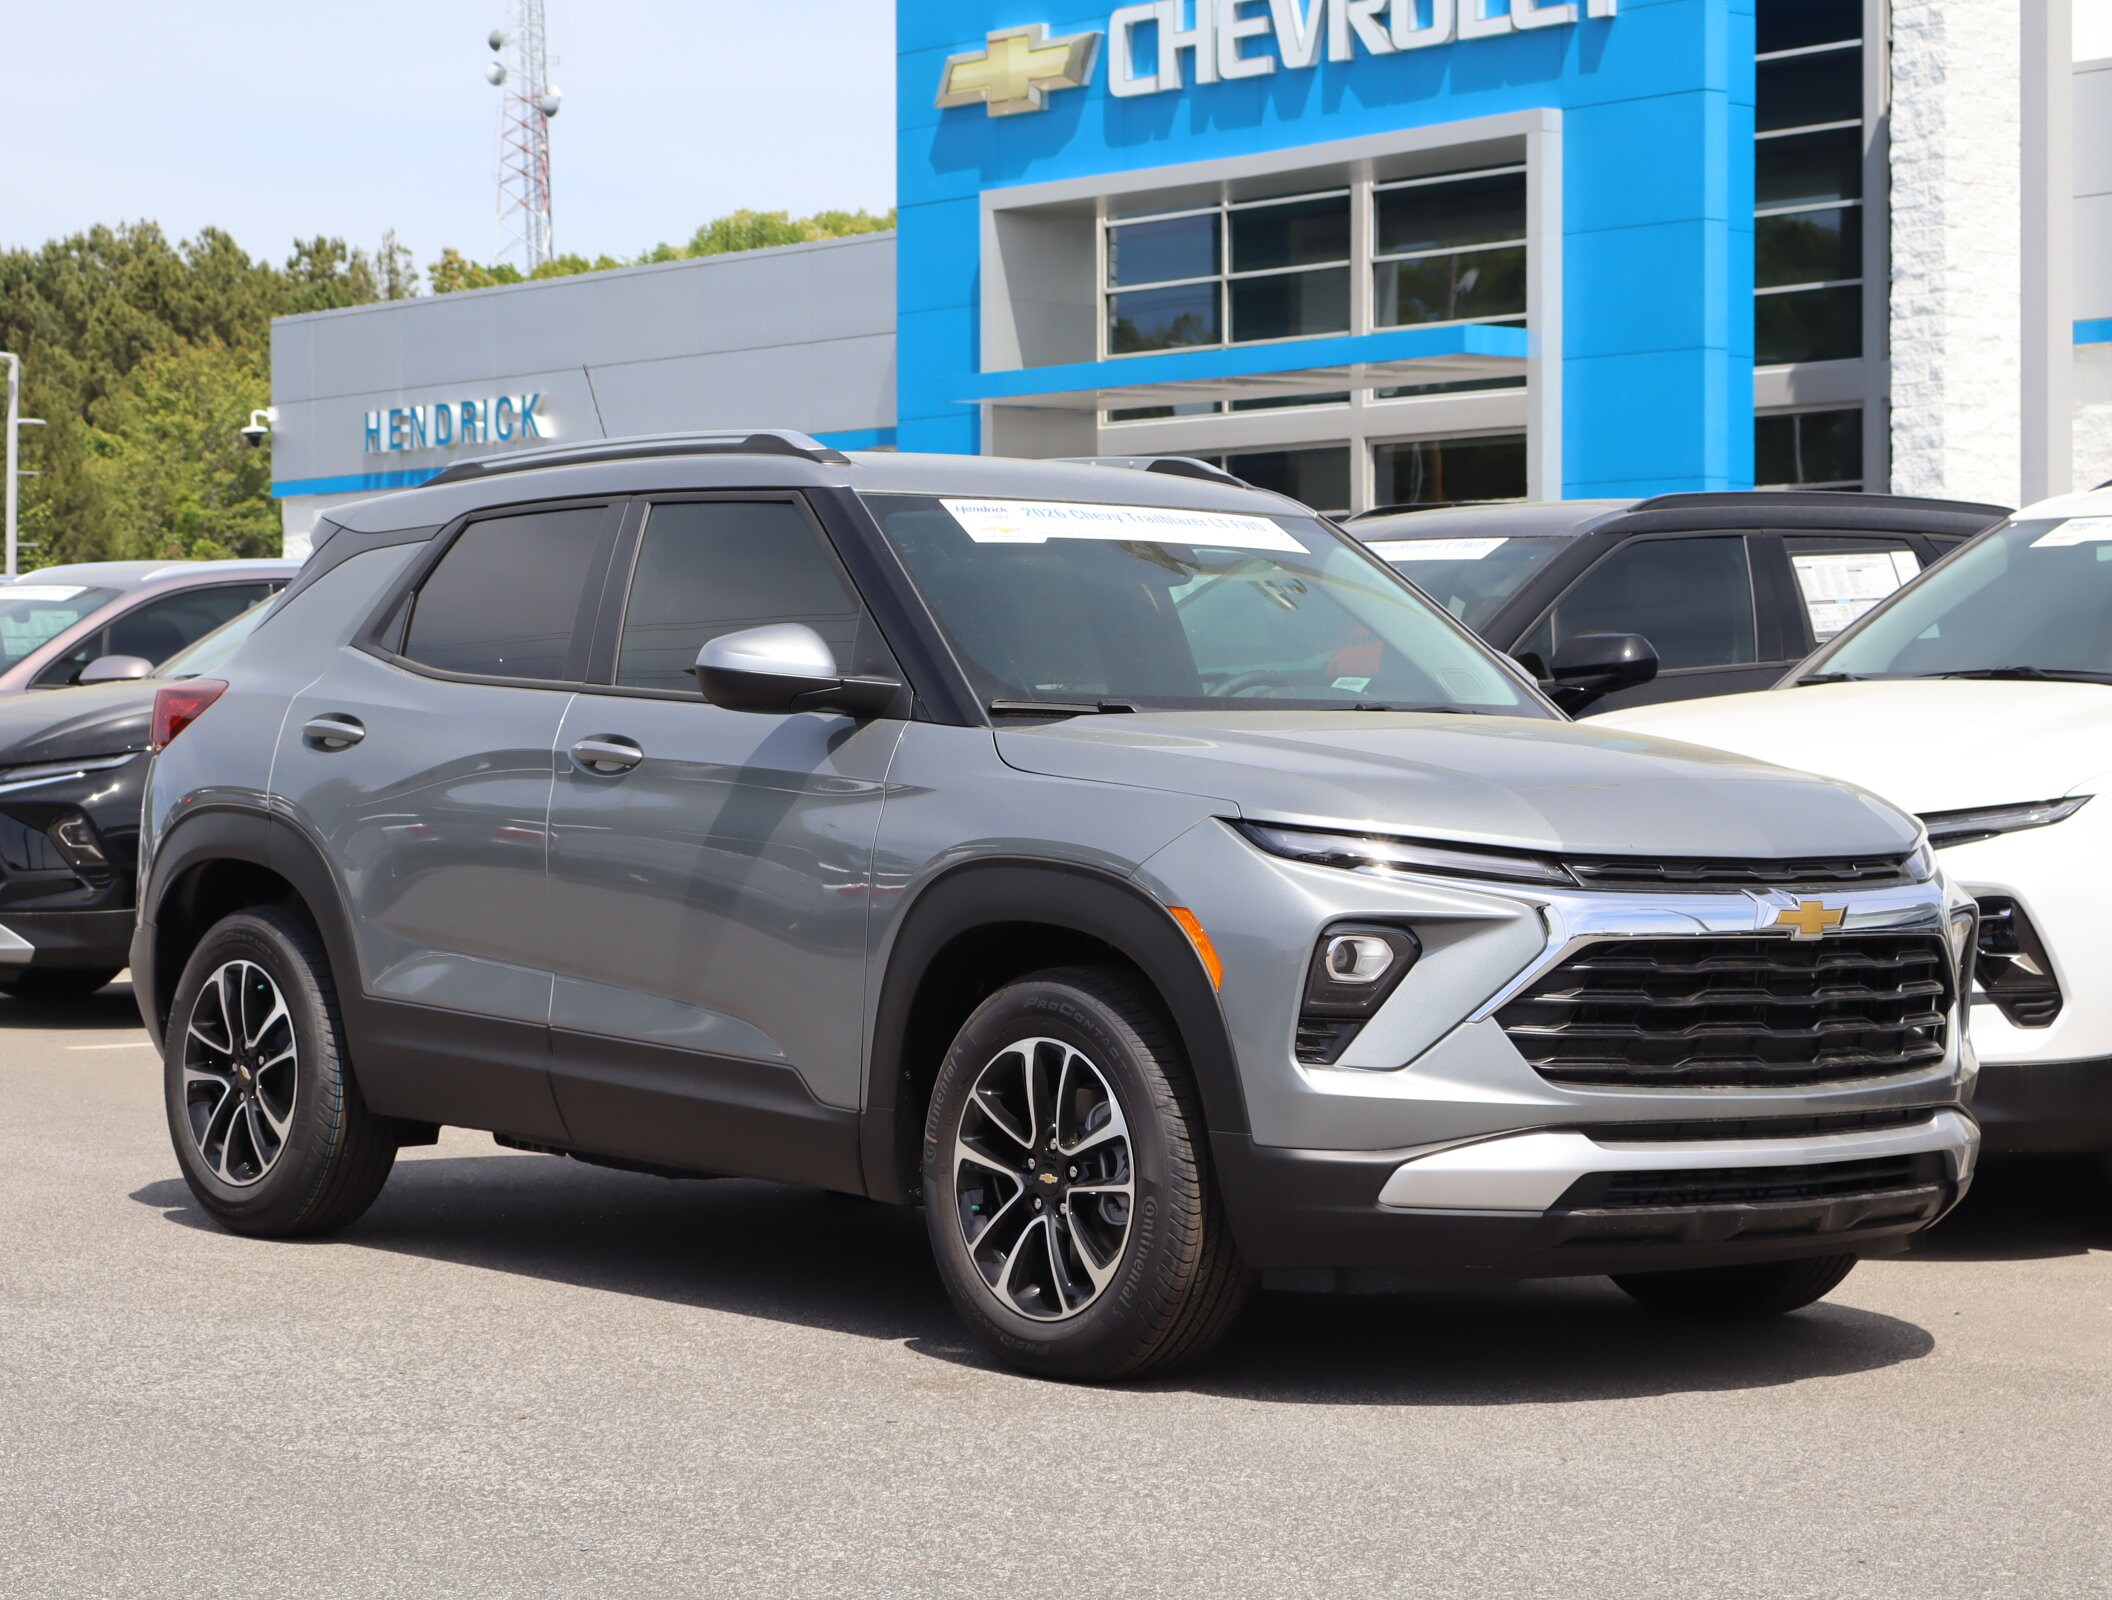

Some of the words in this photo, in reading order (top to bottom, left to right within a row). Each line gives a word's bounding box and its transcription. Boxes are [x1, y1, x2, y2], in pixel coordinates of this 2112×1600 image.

[1108, 0, 1616, 98] CHEVROL
[364, 393, 543, 453] HENDRICK
[955, 504, 1008, 515] Hendrick
[1020, 507, 1067, 519] 2026
[1068, 509, 1124, 523] Chevy
[1207, 518, 1229, 528] LT
[1117, 1195, 1158, 1308] Continental
